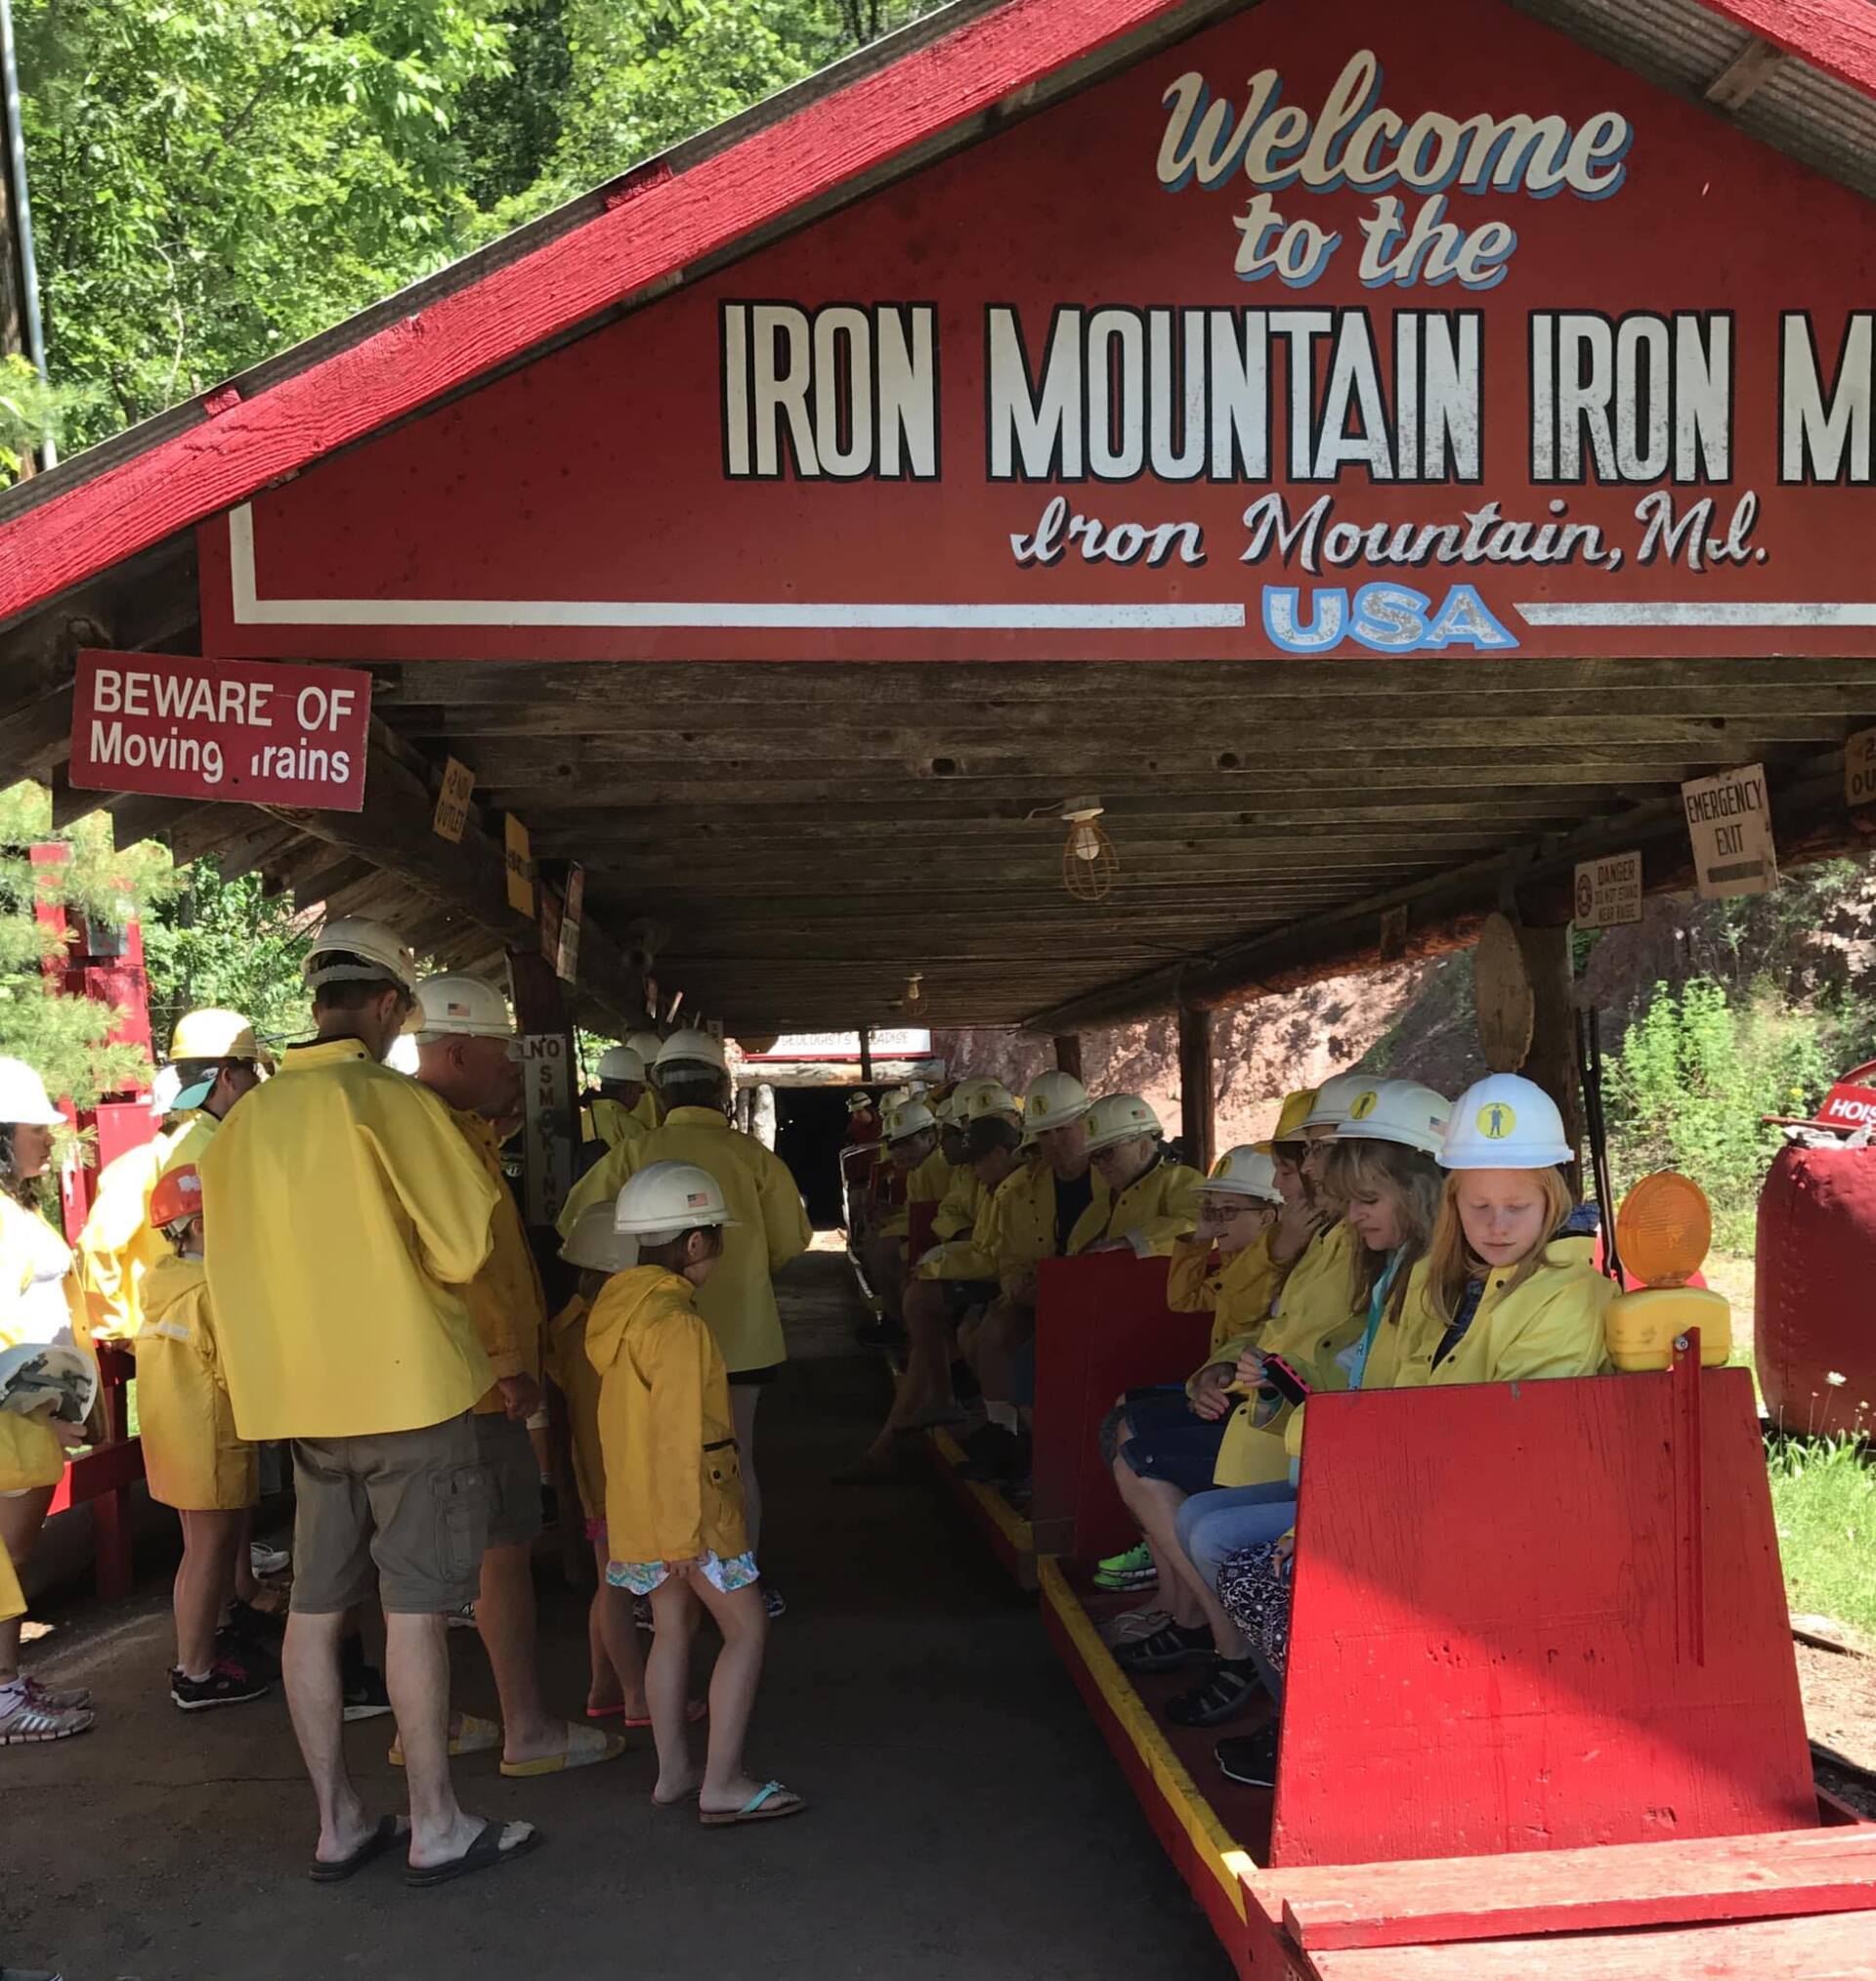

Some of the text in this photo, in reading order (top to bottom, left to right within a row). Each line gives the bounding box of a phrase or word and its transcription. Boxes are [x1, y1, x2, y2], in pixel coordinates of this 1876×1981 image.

[1157, 49, 1631, 198] Welcome
[1233, 193, 1516, 288] to the
[721, 301, 938, 479] IRON
[987, 305, 1481, 483] MOUNTAIN
[1530, 311, 1733, 485] IRON
[1010, 495, 1207, 569] Iron
[1240, 493, 1621, 576] Mountain,
[1262, 582, 1518, 652] USA
[94, 669, 356, 731] BEWARE OF
[90, 720, 224, 783] Moving
[438, 801, 464, 834] OUTLET
[1686, 779, 1763, 824] EMERGENCY
[1715, 824, 1743, 856] EXIT
[1598, 859, 1635, 886] DANGER
[531, 1039, 561, 1059] NO
[538, 1064, 558, 1215] SMOKING
